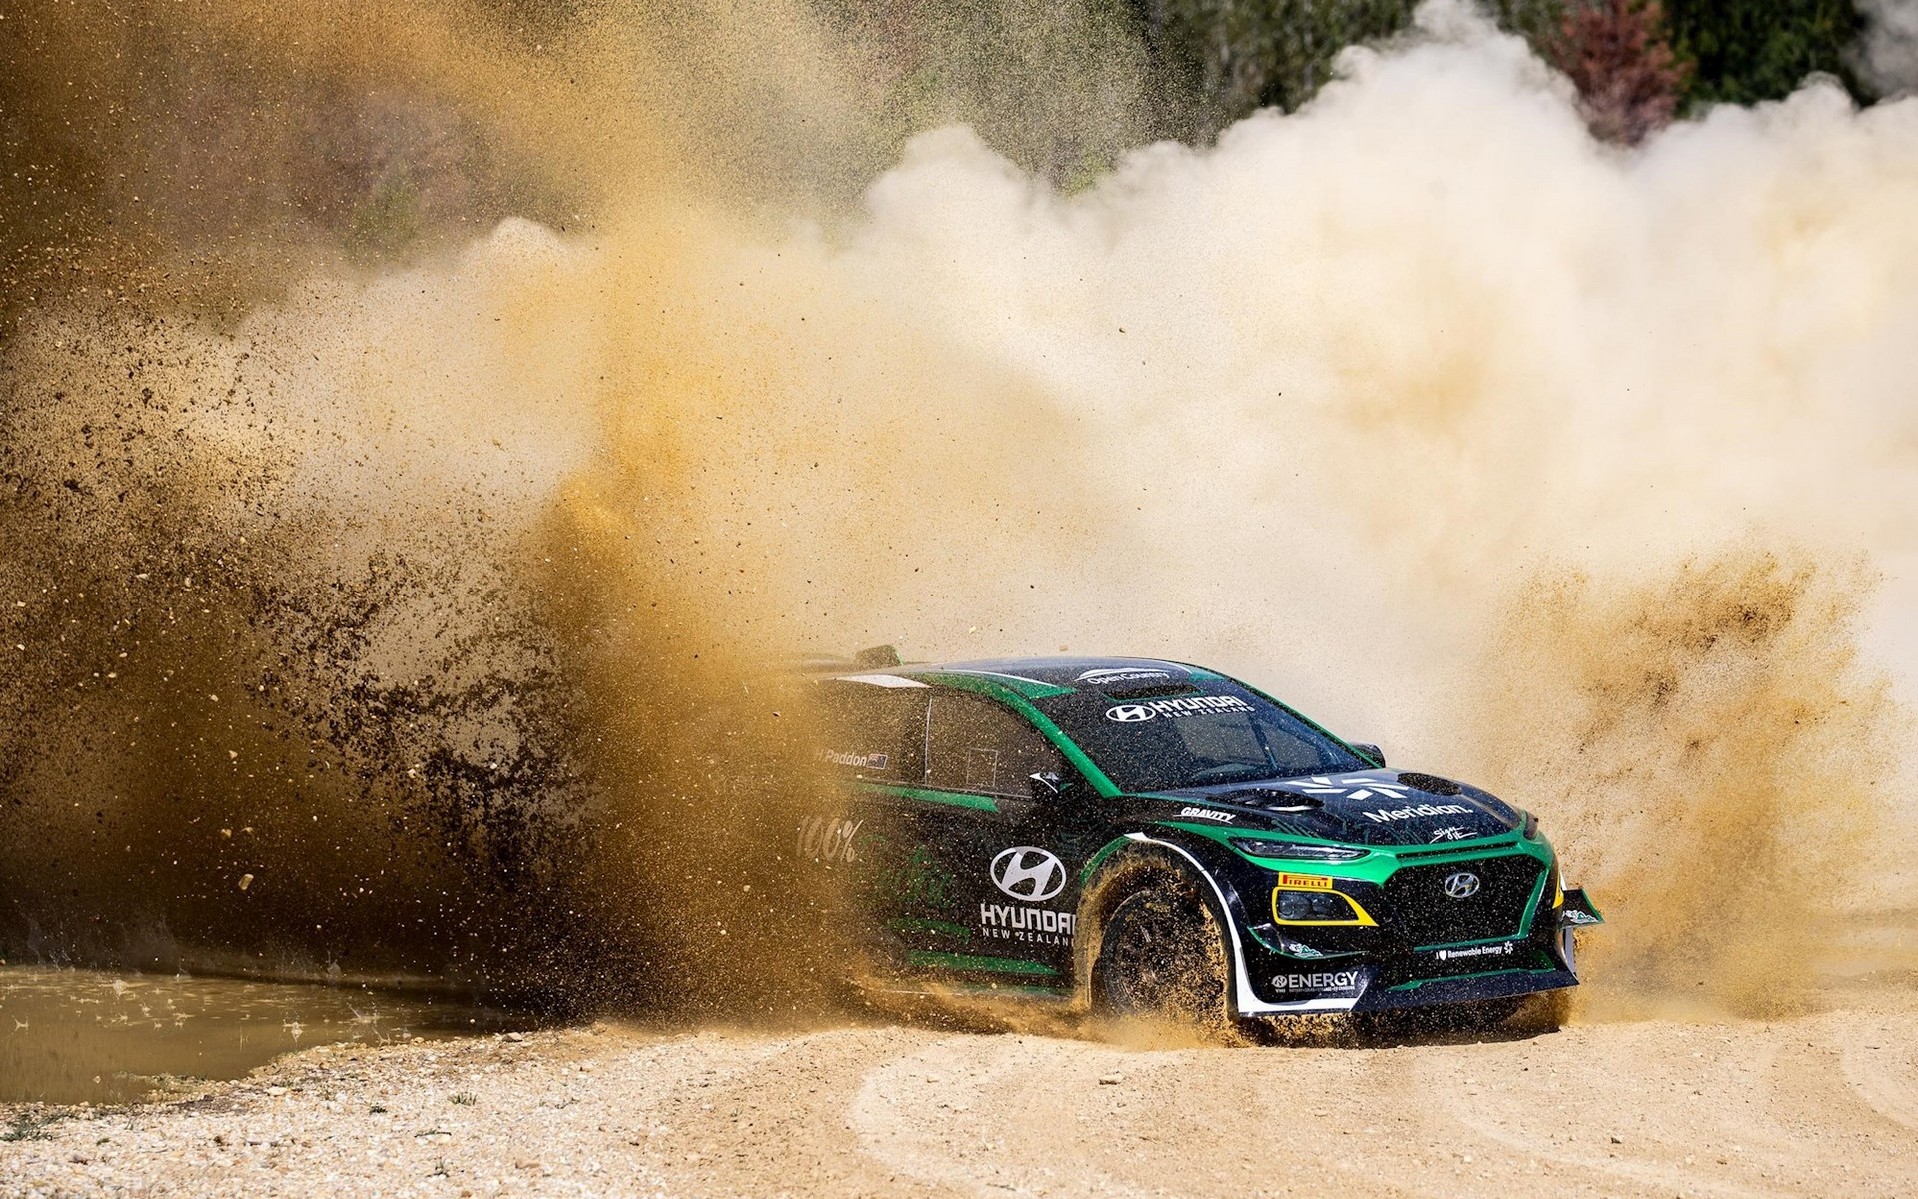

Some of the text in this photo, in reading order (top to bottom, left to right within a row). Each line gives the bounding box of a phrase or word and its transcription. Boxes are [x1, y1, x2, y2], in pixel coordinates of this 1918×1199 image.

[1148, 695, 1248, 713] HYUNDAI
[1163, 705, 1256, 719] NEW ZEALAND
[825, 749, 868, 767] Paddon
[1180, 806, 1237, 822] GRAVITY
[796, 815, 864, 864] 100%
[1282, 874, 1329, 888] PIRELLI
[982, 927, 1011, 940] NEW
[1447, 947, 1482, 959] Renewable
[1482, 945, 1503, 955] Energy
[1288, 970, 1359, 988] ENERGY
